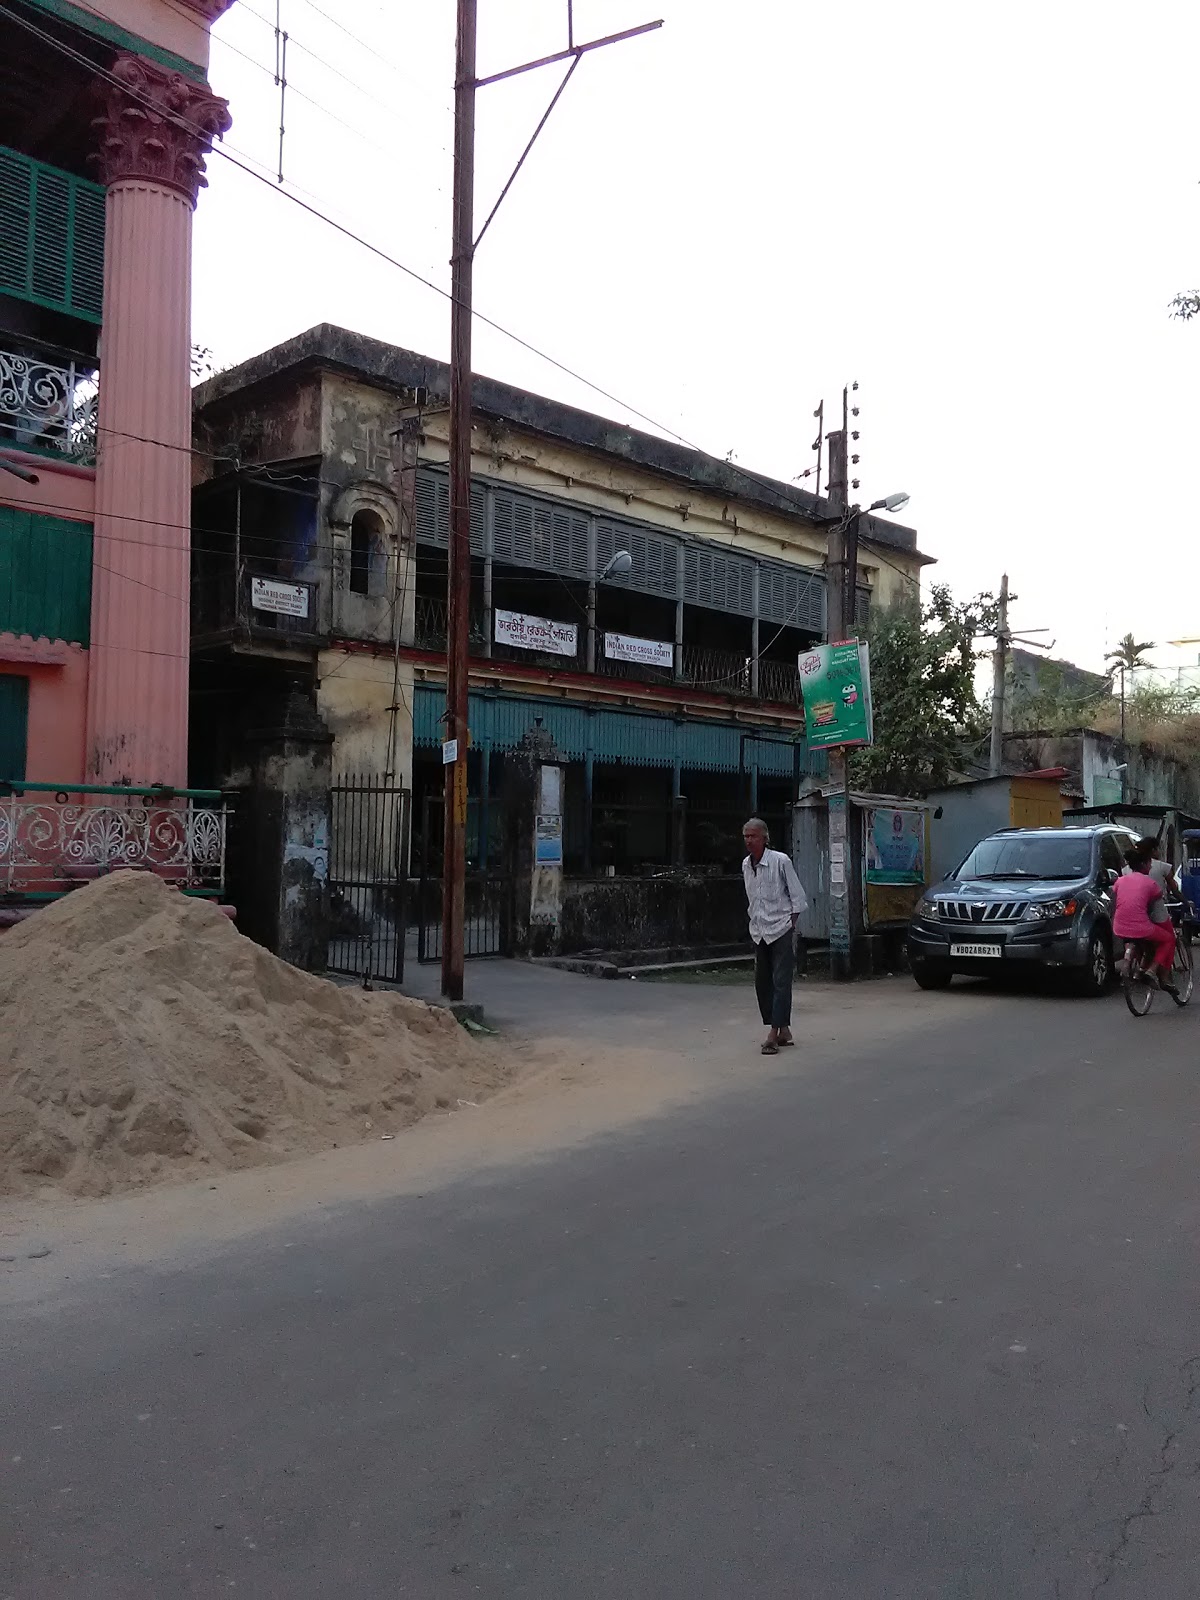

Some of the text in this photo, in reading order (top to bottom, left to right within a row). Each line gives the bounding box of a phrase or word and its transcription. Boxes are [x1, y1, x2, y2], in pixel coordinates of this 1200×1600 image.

[270, 591, 278, 599] RED
[606, 640, 671, 658] INDIAN RED CROSS SOCIETY
